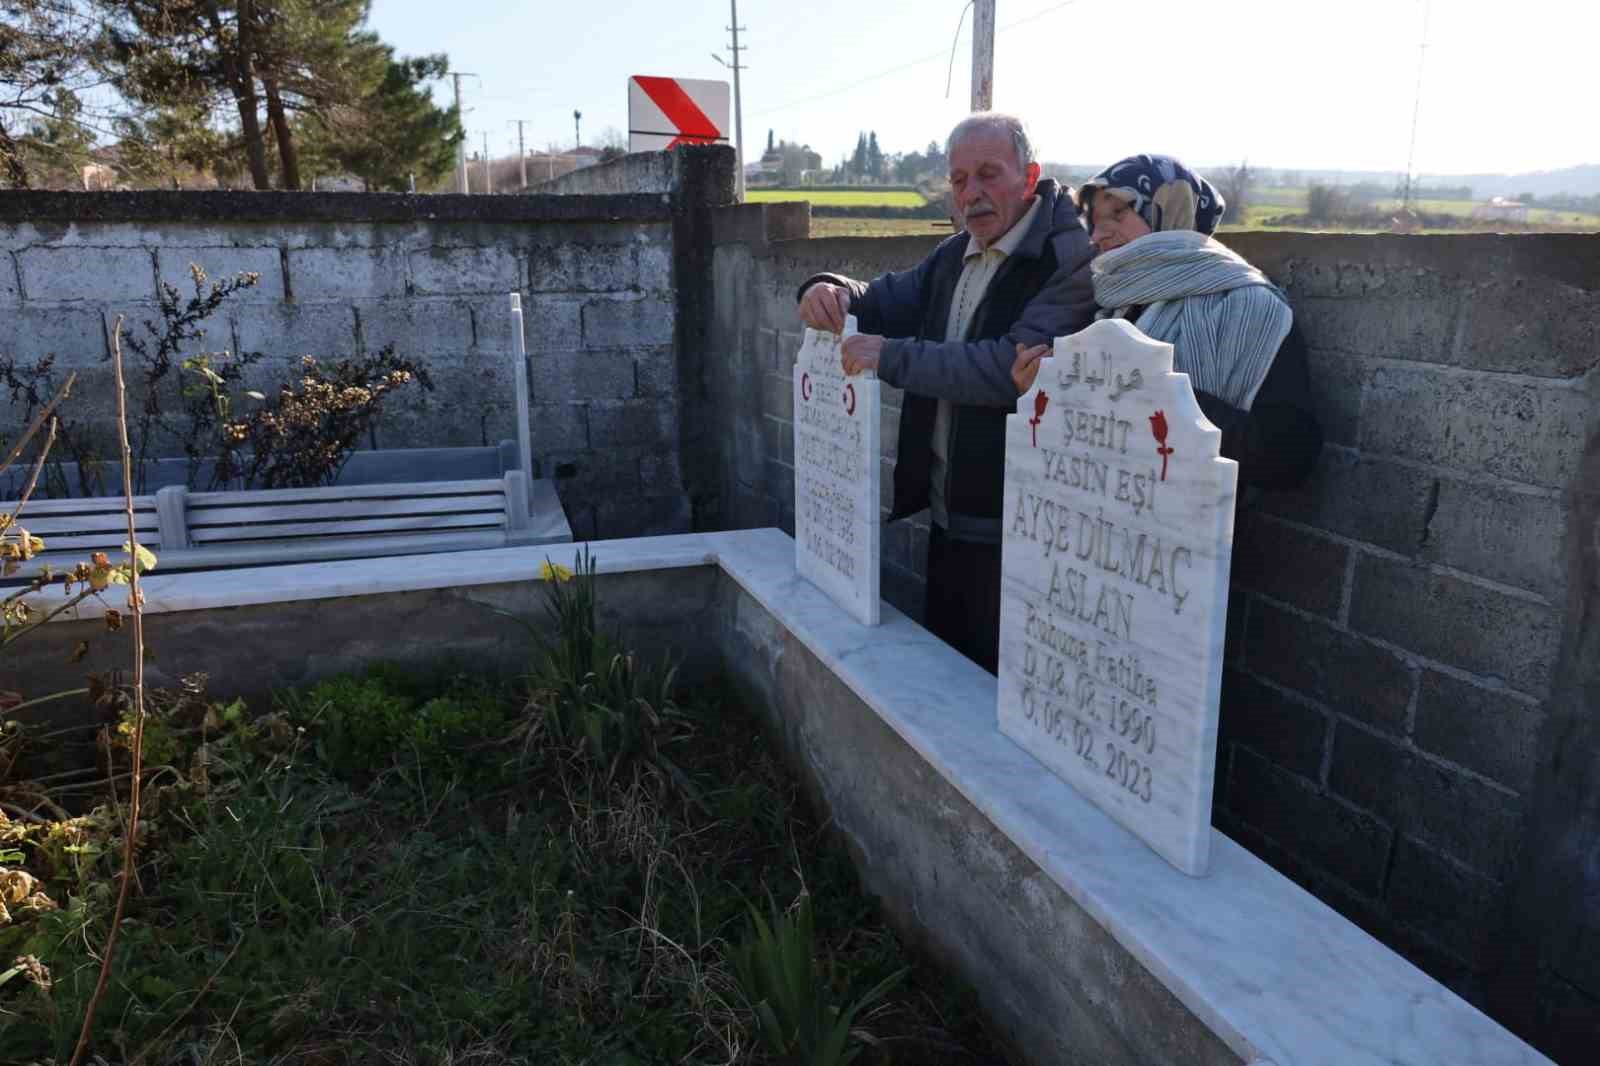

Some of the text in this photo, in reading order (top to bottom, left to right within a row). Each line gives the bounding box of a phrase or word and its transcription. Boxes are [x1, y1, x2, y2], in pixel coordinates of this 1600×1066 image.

[1063, 408, 1132, 454] ŞEHİT
[1041, 447, 1157, 516] YASİN EŞİ
[1012, 487, 1192, 616] AYŞE DİLMAÇ
[1046, 561, 1135, 640] ASLAN
[1106, 742, 1153, 803] 2023
